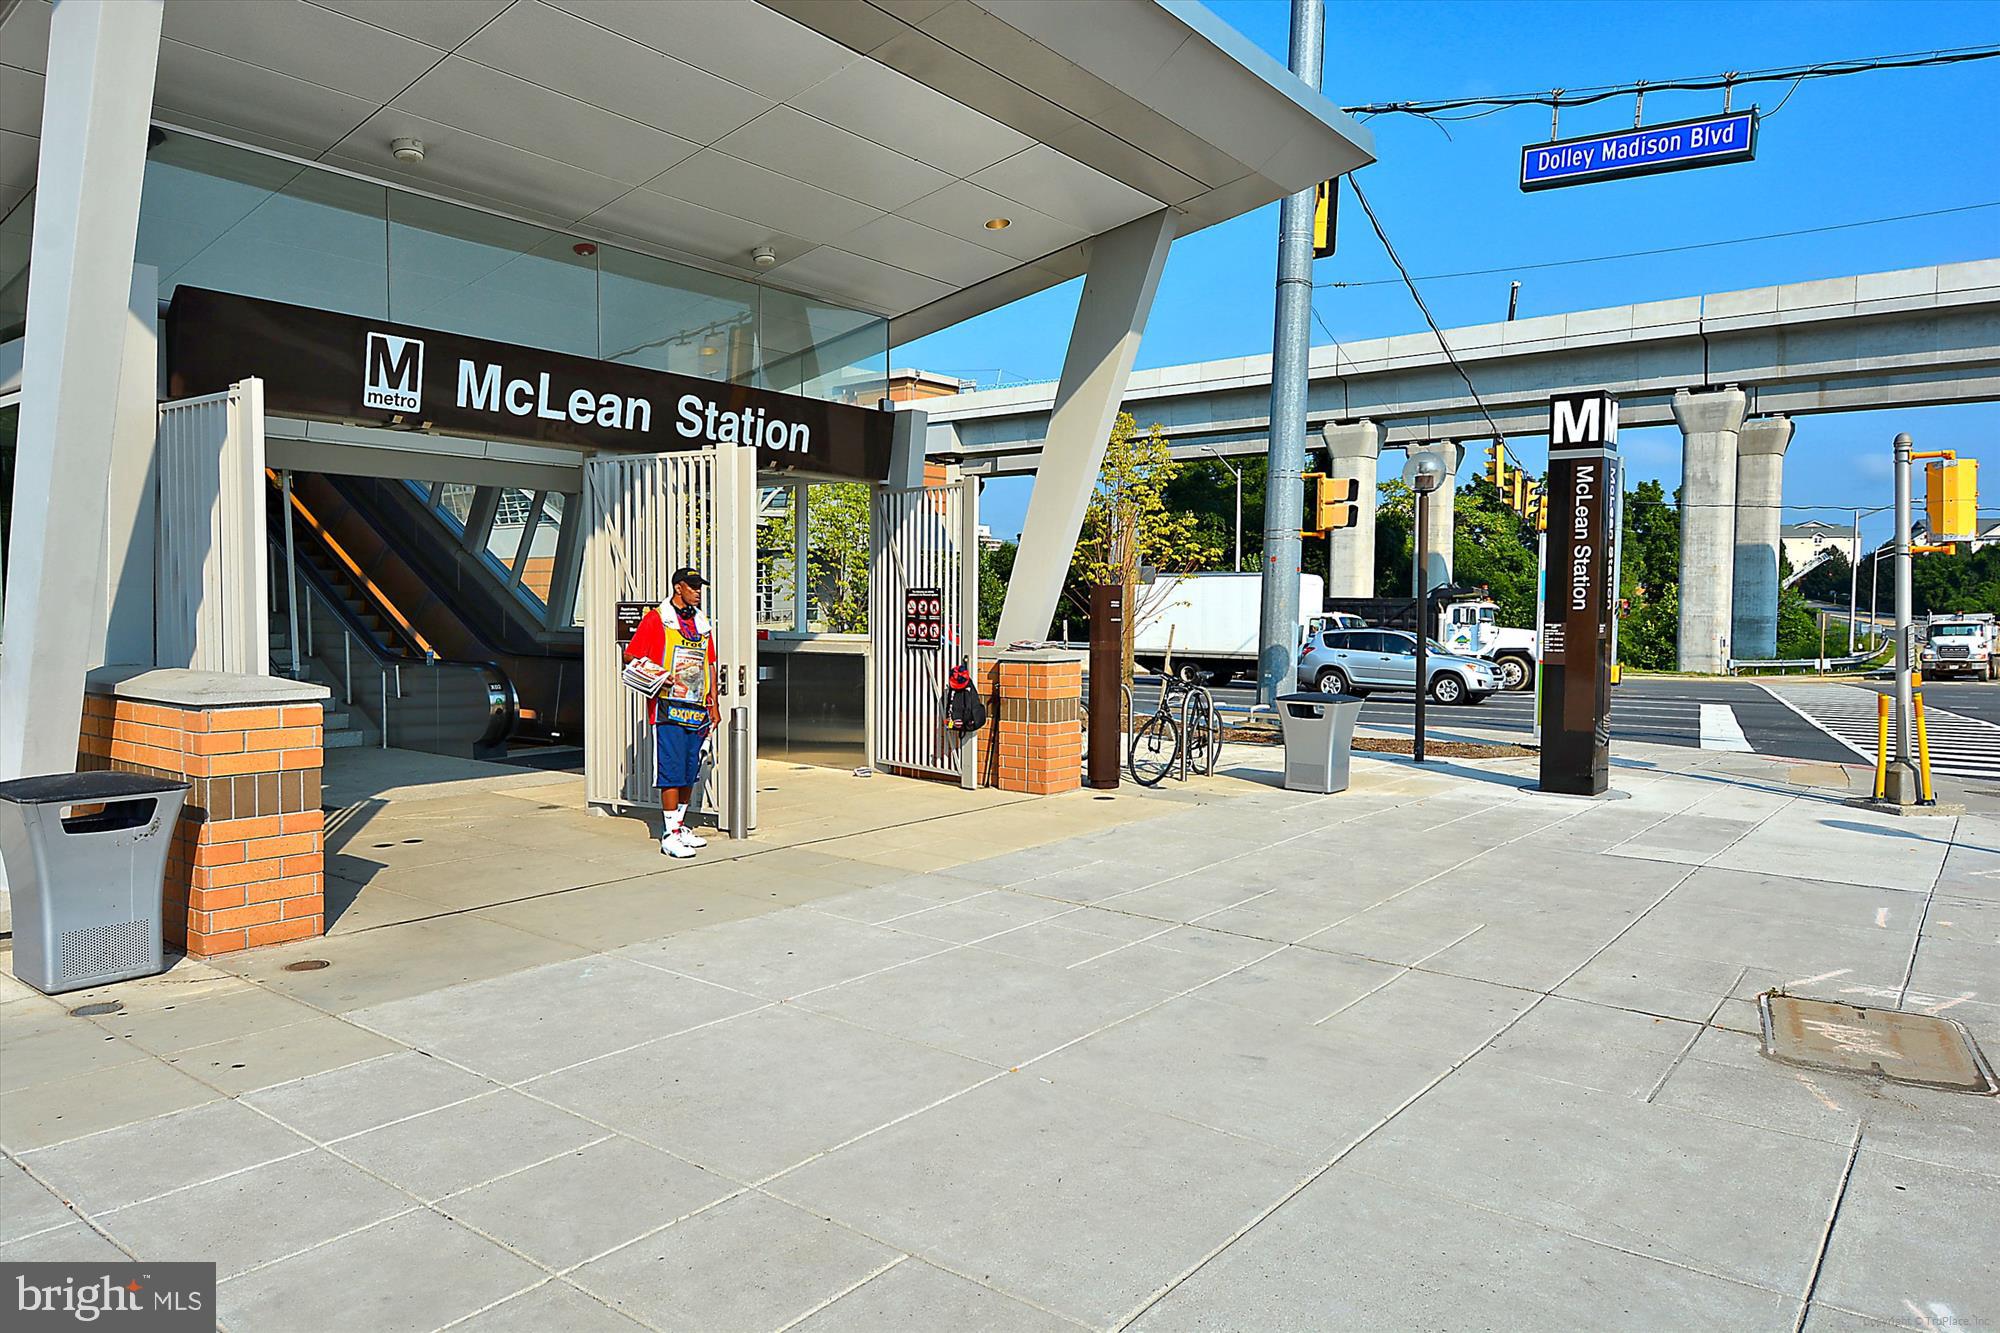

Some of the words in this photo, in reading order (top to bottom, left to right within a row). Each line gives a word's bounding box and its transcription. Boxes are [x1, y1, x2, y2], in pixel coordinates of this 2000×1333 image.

[1538, 148, 1595, 171] Dolley
[1602, 134, 1681, 162] Madison
[1690, 122, 1735, 148] Blvd
[369, 336, 420, 392] M
[368, 392, 417, 409] metro
[456, 359, 652, 432] McLean
[676, 394, 811, 453] Station
[1552, 398, 1601, 444] M
[1604, 397, 1619, 444] M
[1574, 465, 1594, 540] McLean
[1608, 467, 1616, 542] McLean
[1572, 544, 1592, 611] Station
[1606, 545, 1615, 610] Station
